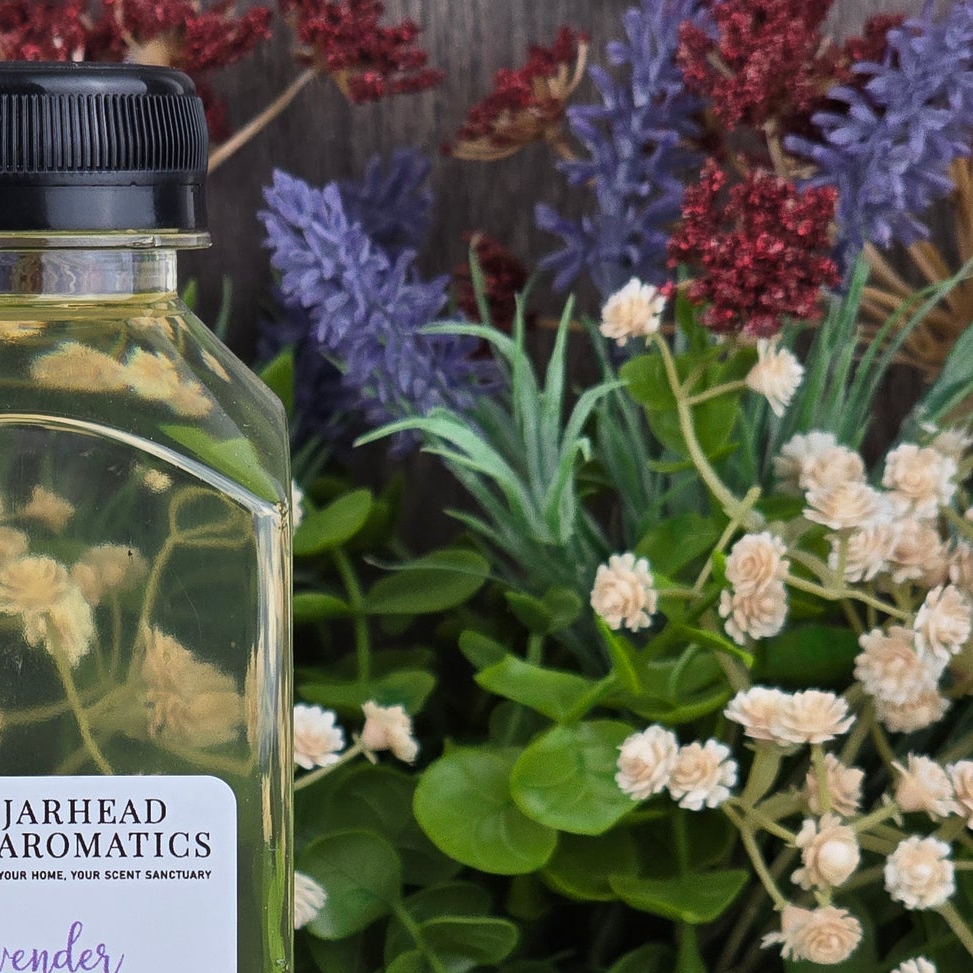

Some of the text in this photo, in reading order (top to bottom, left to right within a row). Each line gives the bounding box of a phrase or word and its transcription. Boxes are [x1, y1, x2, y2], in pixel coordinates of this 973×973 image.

[1, 799, 166, 830] JARHEAD
[31, 870, 66, 881] HOME,
[70, 870, 100, 880] YOUR
[104, 870, 141, 880] SCENT
[145, 869, 211, 881] SANCTUARY
